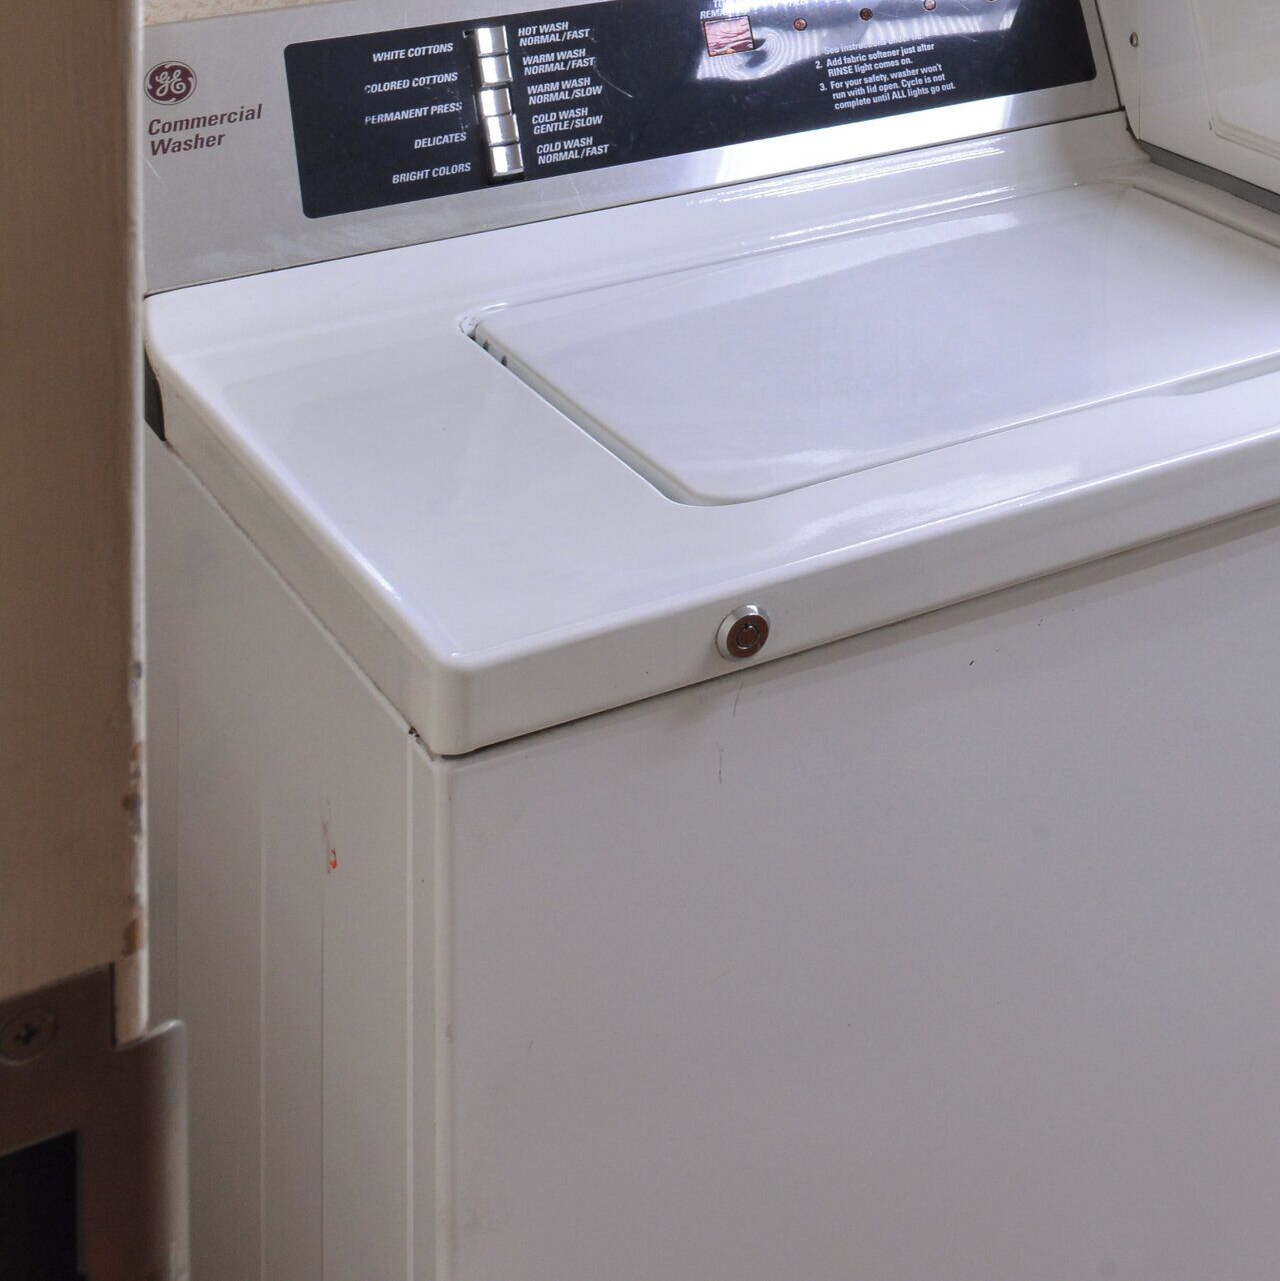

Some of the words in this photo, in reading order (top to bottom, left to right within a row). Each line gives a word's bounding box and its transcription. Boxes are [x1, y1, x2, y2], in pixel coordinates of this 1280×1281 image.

[518, 25, 538, 37] HOT
[539, 21, 569, 34] WASH
[372, 49, 406, 63] WHITE
[407, 43, 454, 58] COTTONS
[522, 52, 555, 66] WARM
[556, 48, 586, 61] WASH
[815, 60, 823, 70] 2.
[826, 57, 842, 68] Add
[844, 53, 867, 65] fabric
[868, 49, 900, 60] softener
[901, 46, 916, 57] just
[917, 43, 935, 53] after
[824, 46, 840, 55] See
[820, 83, 827, 92] 3.
[830, 80, 844, 90] For
[845, 77, 862, 89] your
[864, 74, 889, 86] safety,
[890, 68, 919, 79] washer
[921, 63, 942, 75] won't
[828, 66, 856, 78] RINSE
[855, 63, 873, 75] light
[874, 60, 899, 70] comes
[364, 79, 410, 94] COLORED
[411, 72, 459, 87] COTTONS
[527, 81, 560, 95] WARM
[561, 77, 591, 90] WASH
[832, 91, 846, 100] run
[847, 87, 866, 98] with
[866, 85, 878, 95] lid
[879, 83, 900, 94] open.
[901, 76, 923, 89] Cycle
[924, 75, 932, 84] is
[933, 73, 946, 83] not
[835, 97, 872, 110] complete
[872, 92, 891, 104] until
[891, 88, 907, 101] ALL
[907, 86, 930, 98] lights
[930, 86, 941, 96] go
[941, 82, 957, 92] out.
[148, 103, 263, 136] Commercial
[364, 107, 429, 125] PERMANENT
[430, 102, 463, 115] PRESS
[532, 112, 557, 125] COLD
[559, 107, 588, 120] WASH
[533, 115, 603, 135] GENTLE/SLOW
[150, 133, 226, 157] Washer
[414, 132, 467, 149] DELICATES
[536, 142, 561, 154] COLD
[563, 136, 593, 150] WASH
[392, 169, 431, 184] BRIGHT
[432, 162, 471, 178] COLORS
